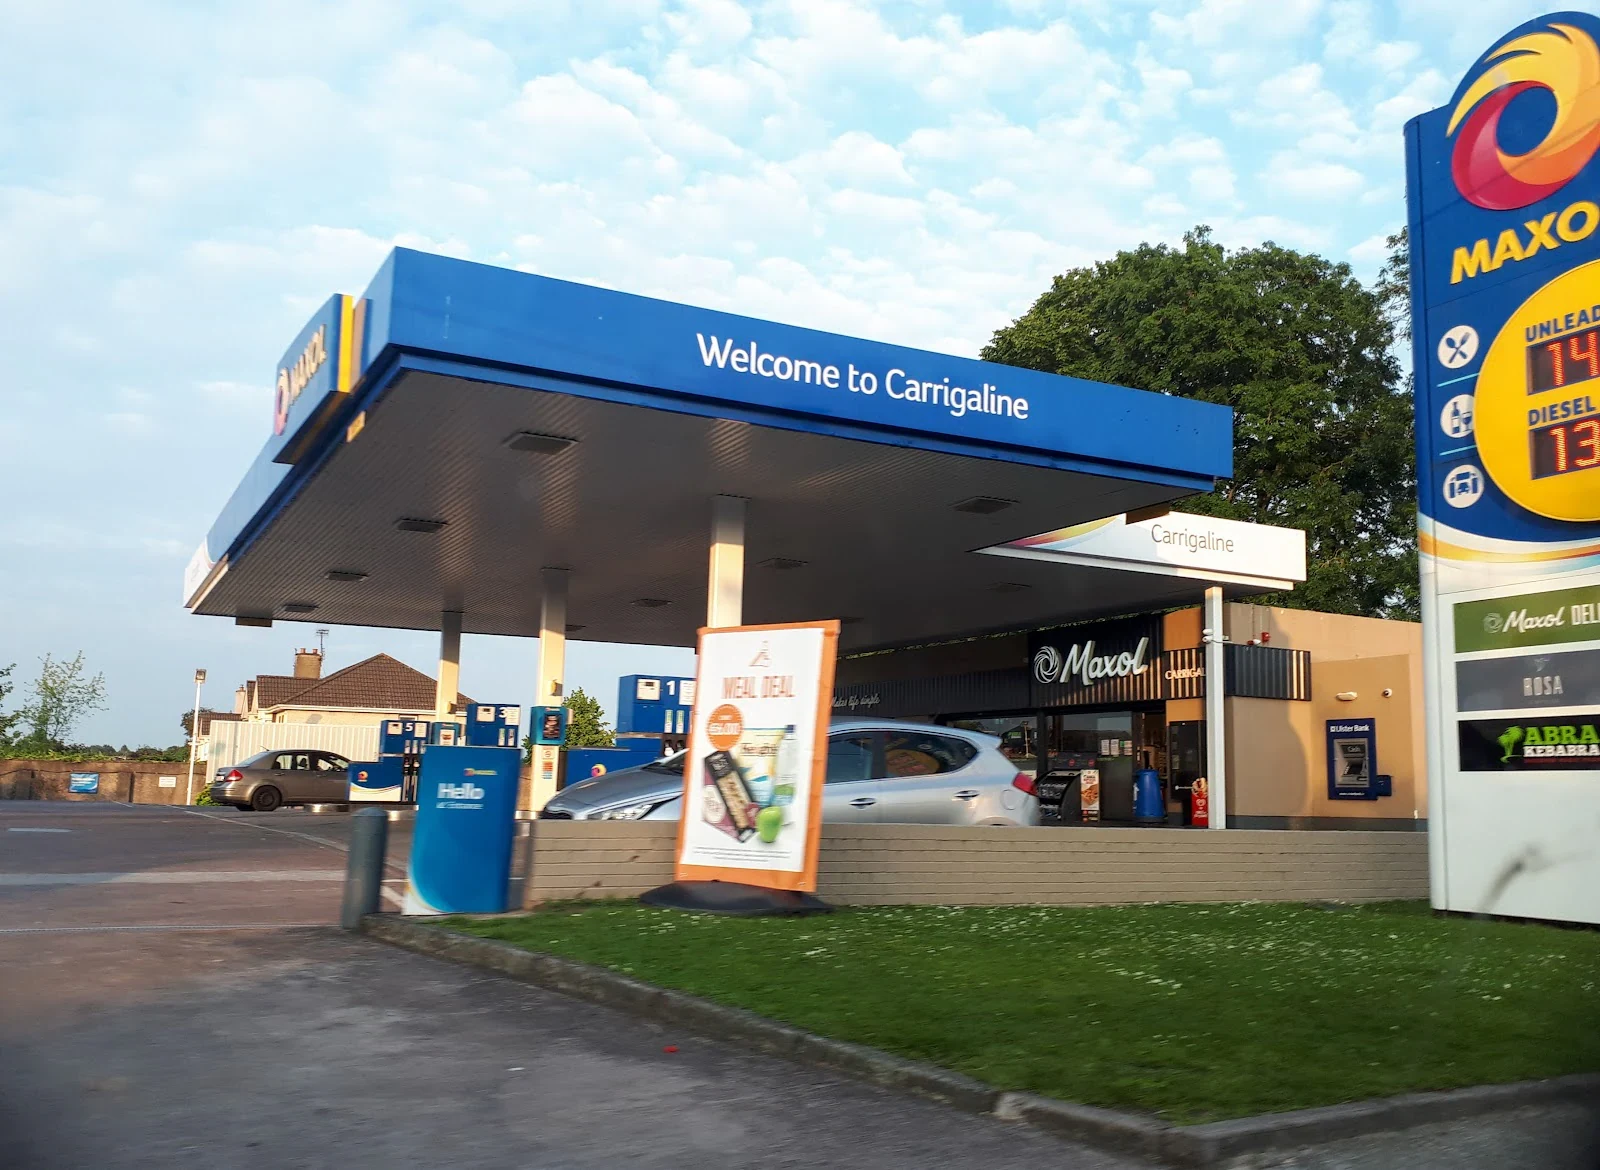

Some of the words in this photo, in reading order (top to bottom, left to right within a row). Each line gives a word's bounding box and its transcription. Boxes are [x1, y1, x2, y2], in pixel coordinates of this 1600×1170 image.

[1450, 201, 1600, 284] MAXO
[696, 332, 840, 389] Welcome
[848, 364, 878, 395] to
[885, 368, 1029, 420] Carrigaline
[1528, 395, 1596, 427] DIESEL
[1151, 523, 1234, 553] Carrigaline
[1502, 606, 1565, 633] Maxol
[1059, 637, 1149, 686] Maxol
[666, 680, 676, 696] 1
[1523, 675, 1564, 697] ROSA
[498, 707, 508, 719] 3
[405, 722, 413, 732] 5
[1354, 724, 1370, 732] Bank
[1524, 725, 1600, 745] ABRA
[1523, 744, 1600, 757] KEBABRA
[436, 782, 486, 800] Hello
